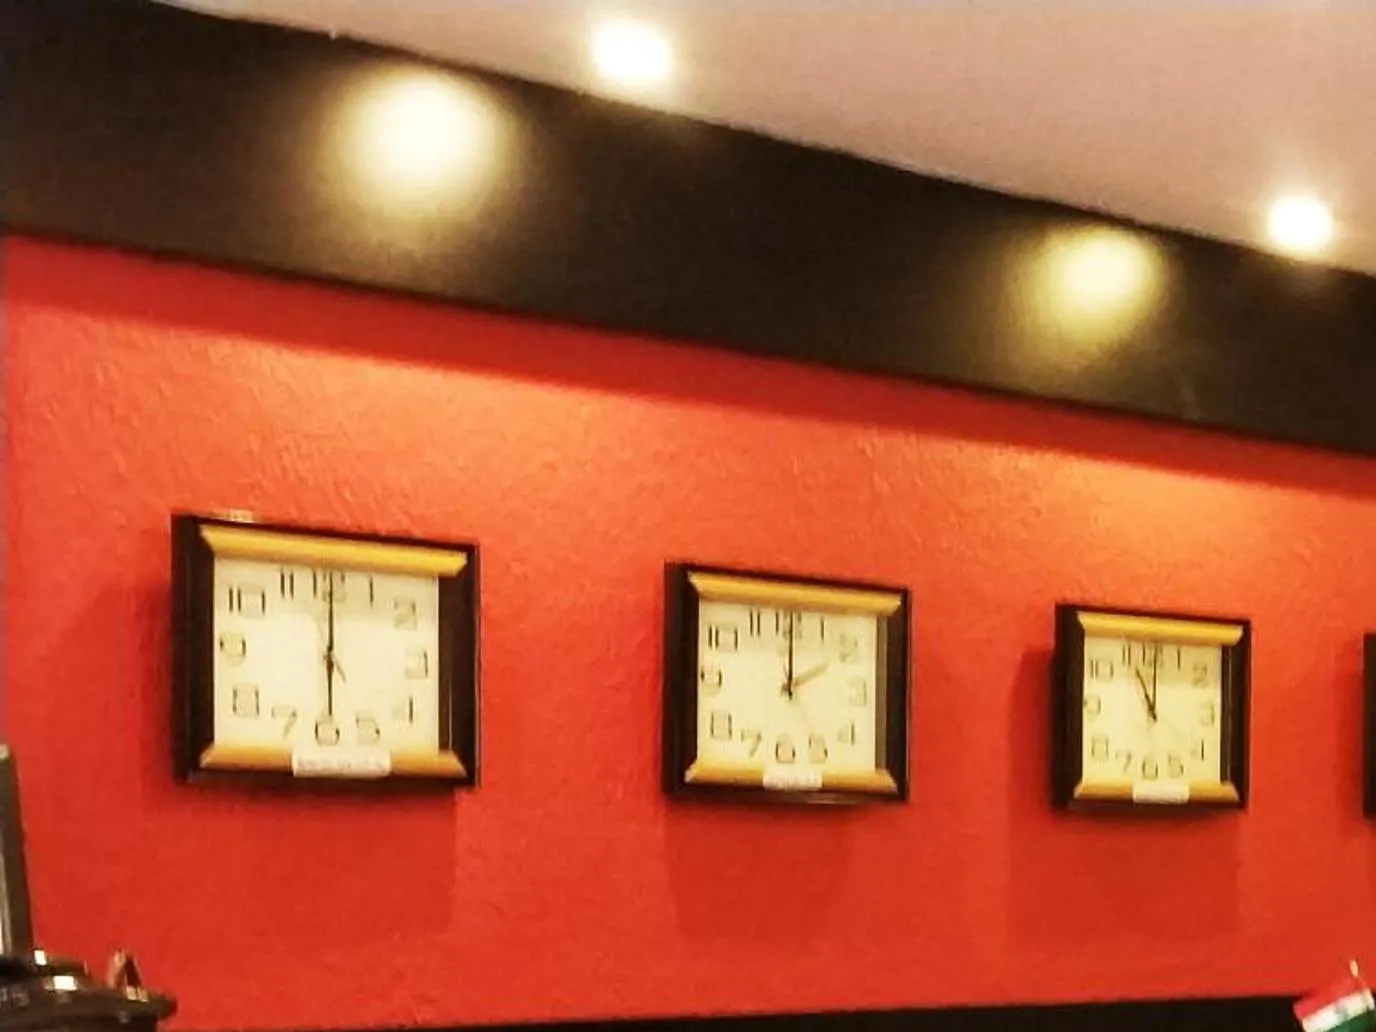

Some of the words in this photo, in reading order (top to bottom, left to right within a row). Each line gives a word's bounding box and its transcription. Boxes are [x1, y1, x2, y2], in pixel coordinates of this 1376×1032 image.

[280, 568, 294, 599] 11
[749, 611, 761, 637] 11
[271, 704, 298, 739] 7
[314, 715, 340, 746] 6
[741, 729, 762, 757] 7
[775, 735, 796, 763] 6
